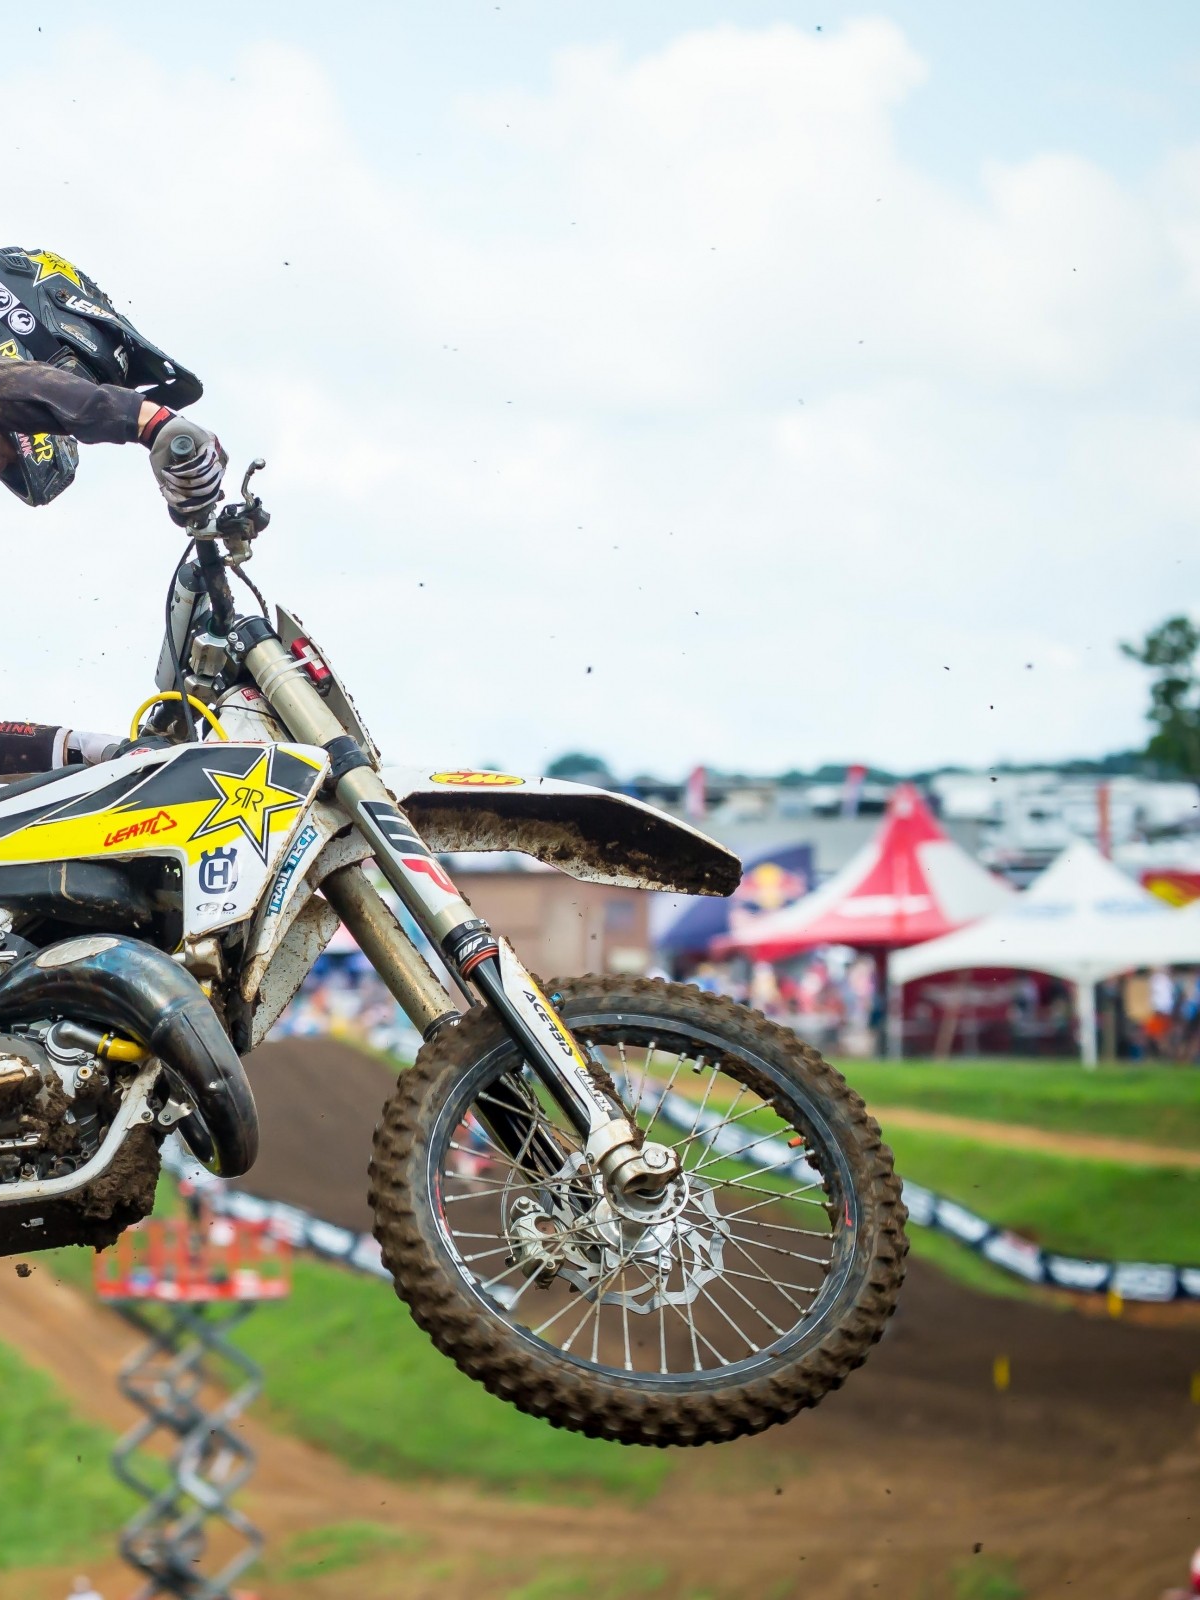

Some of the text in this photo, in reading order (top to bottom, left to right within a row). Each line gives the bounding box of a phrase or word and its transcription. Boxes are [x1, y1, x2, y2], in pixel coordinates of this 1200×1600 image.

[433, 773, 526, 786] FMF
[267, 866, 293, 915] TRAIL
[523, 990, 573, 1056] ACERBIS
